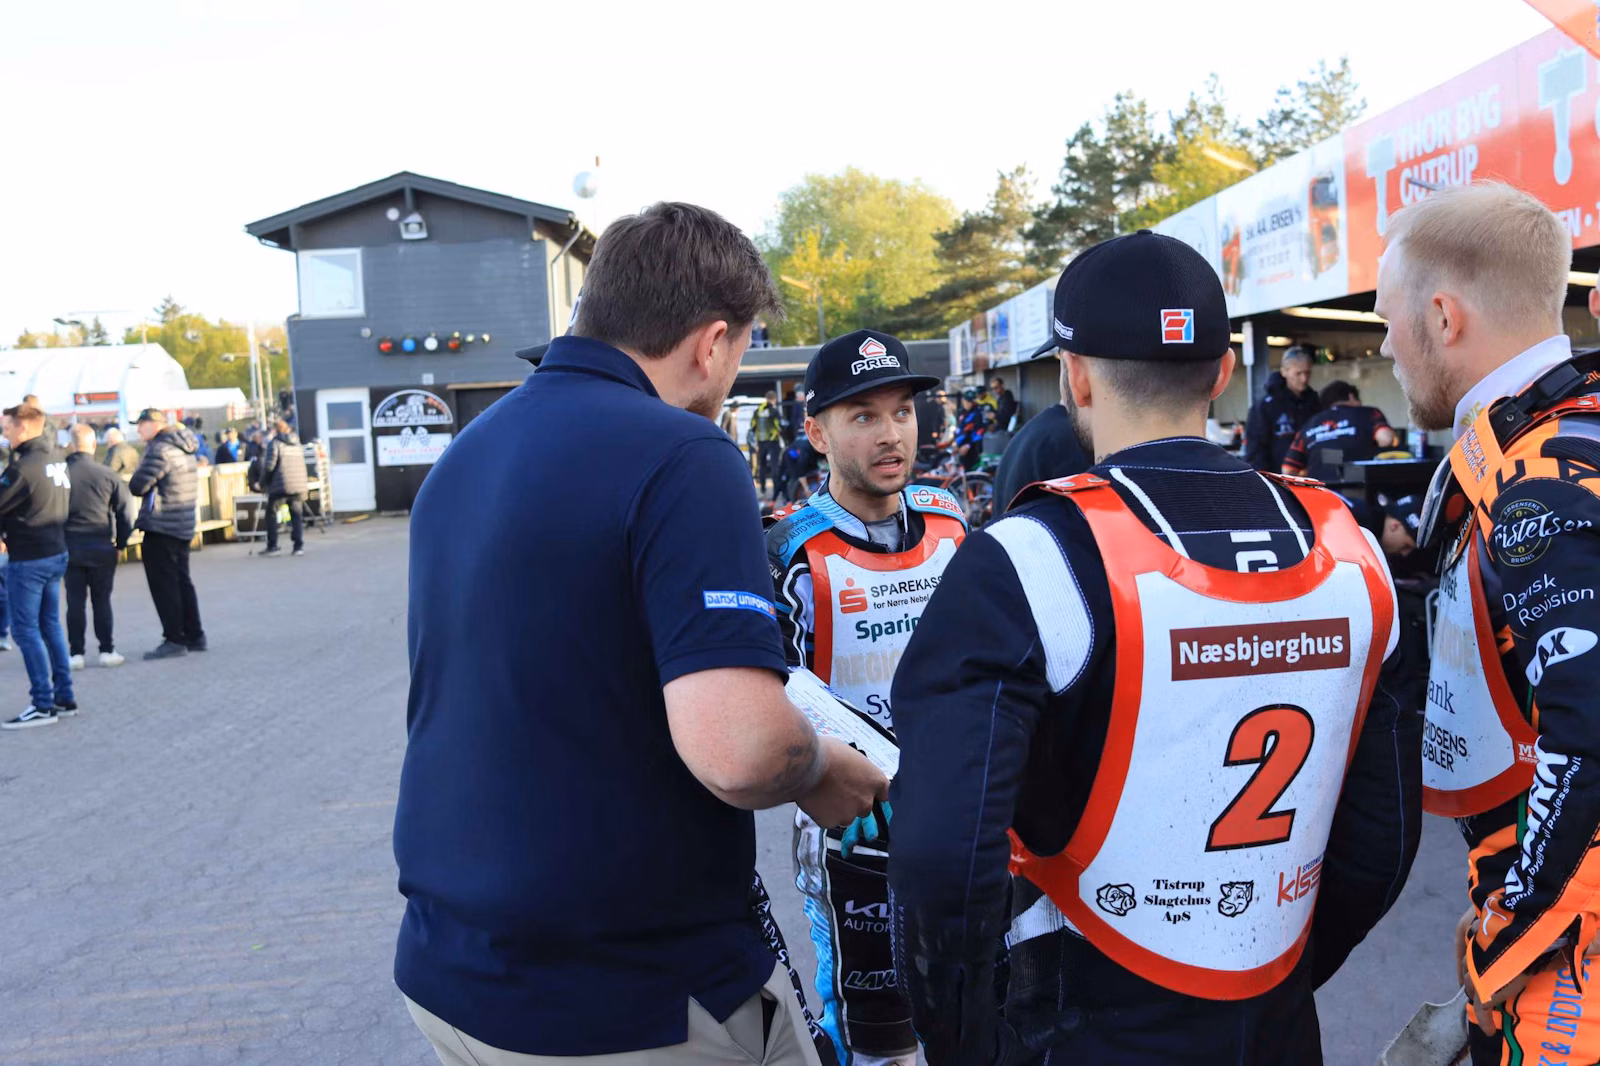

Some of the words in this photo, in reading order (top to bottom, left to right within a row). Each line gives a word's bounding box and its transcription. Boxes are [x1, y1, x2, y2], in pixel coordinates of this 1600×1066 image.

[1395, 106, 1452, 163] THOR
[1457, 84, 1502, 140] BYG
[851, 356, 900, 375] PRES
[873, 601, 886, 609] for
[887, 599, 908, 608] Nørre
[910, 593, 930, 604] Nebel
[1502, 573, 1558, 612] Dansk
[1518, 587, 1595, 627] Revision
[1178, 632, 1344, 667] Næsbjerghus
[1204, 703, 1315, 853] 2
[1528, 839, 1547, 876] bygger
[1143, 894, 1211, 908] Slagtehus
[1152, 879, 1205, 892] Tistrup
[1162, 911, 1192, 925] ApS
